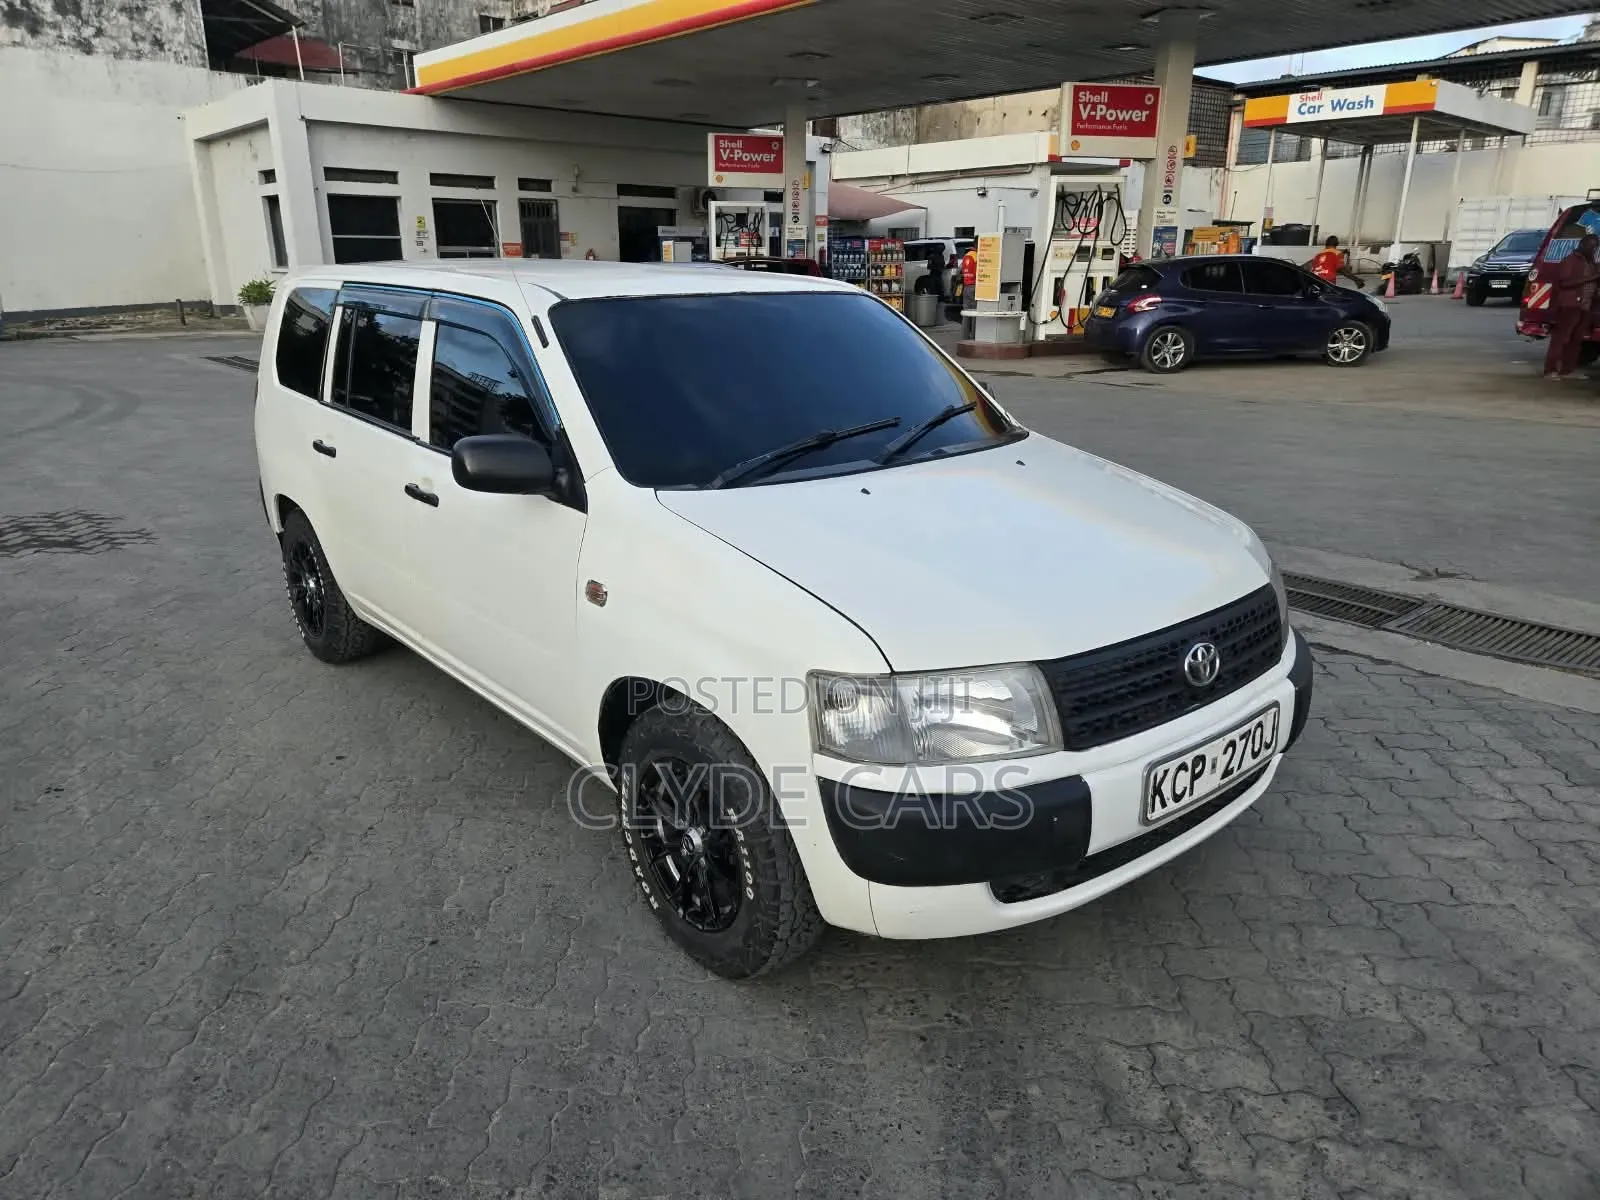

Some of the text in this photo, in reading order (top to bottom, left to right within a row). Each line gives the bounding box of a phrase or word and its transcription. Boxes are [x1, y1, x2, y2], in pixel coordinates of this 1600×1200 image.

[1078, 91, 1108, 103] Shell
[1299, 93, 1323, 103] Shell
[1297, 95, 1374, 116] Car Wash
[1078, 103, 1150, 122] V-Power
[719, 140, 743, 149] Shell
[719, 149, 776, 162] V-Power
[1150, 711, 1277, 813] KCP 270J
